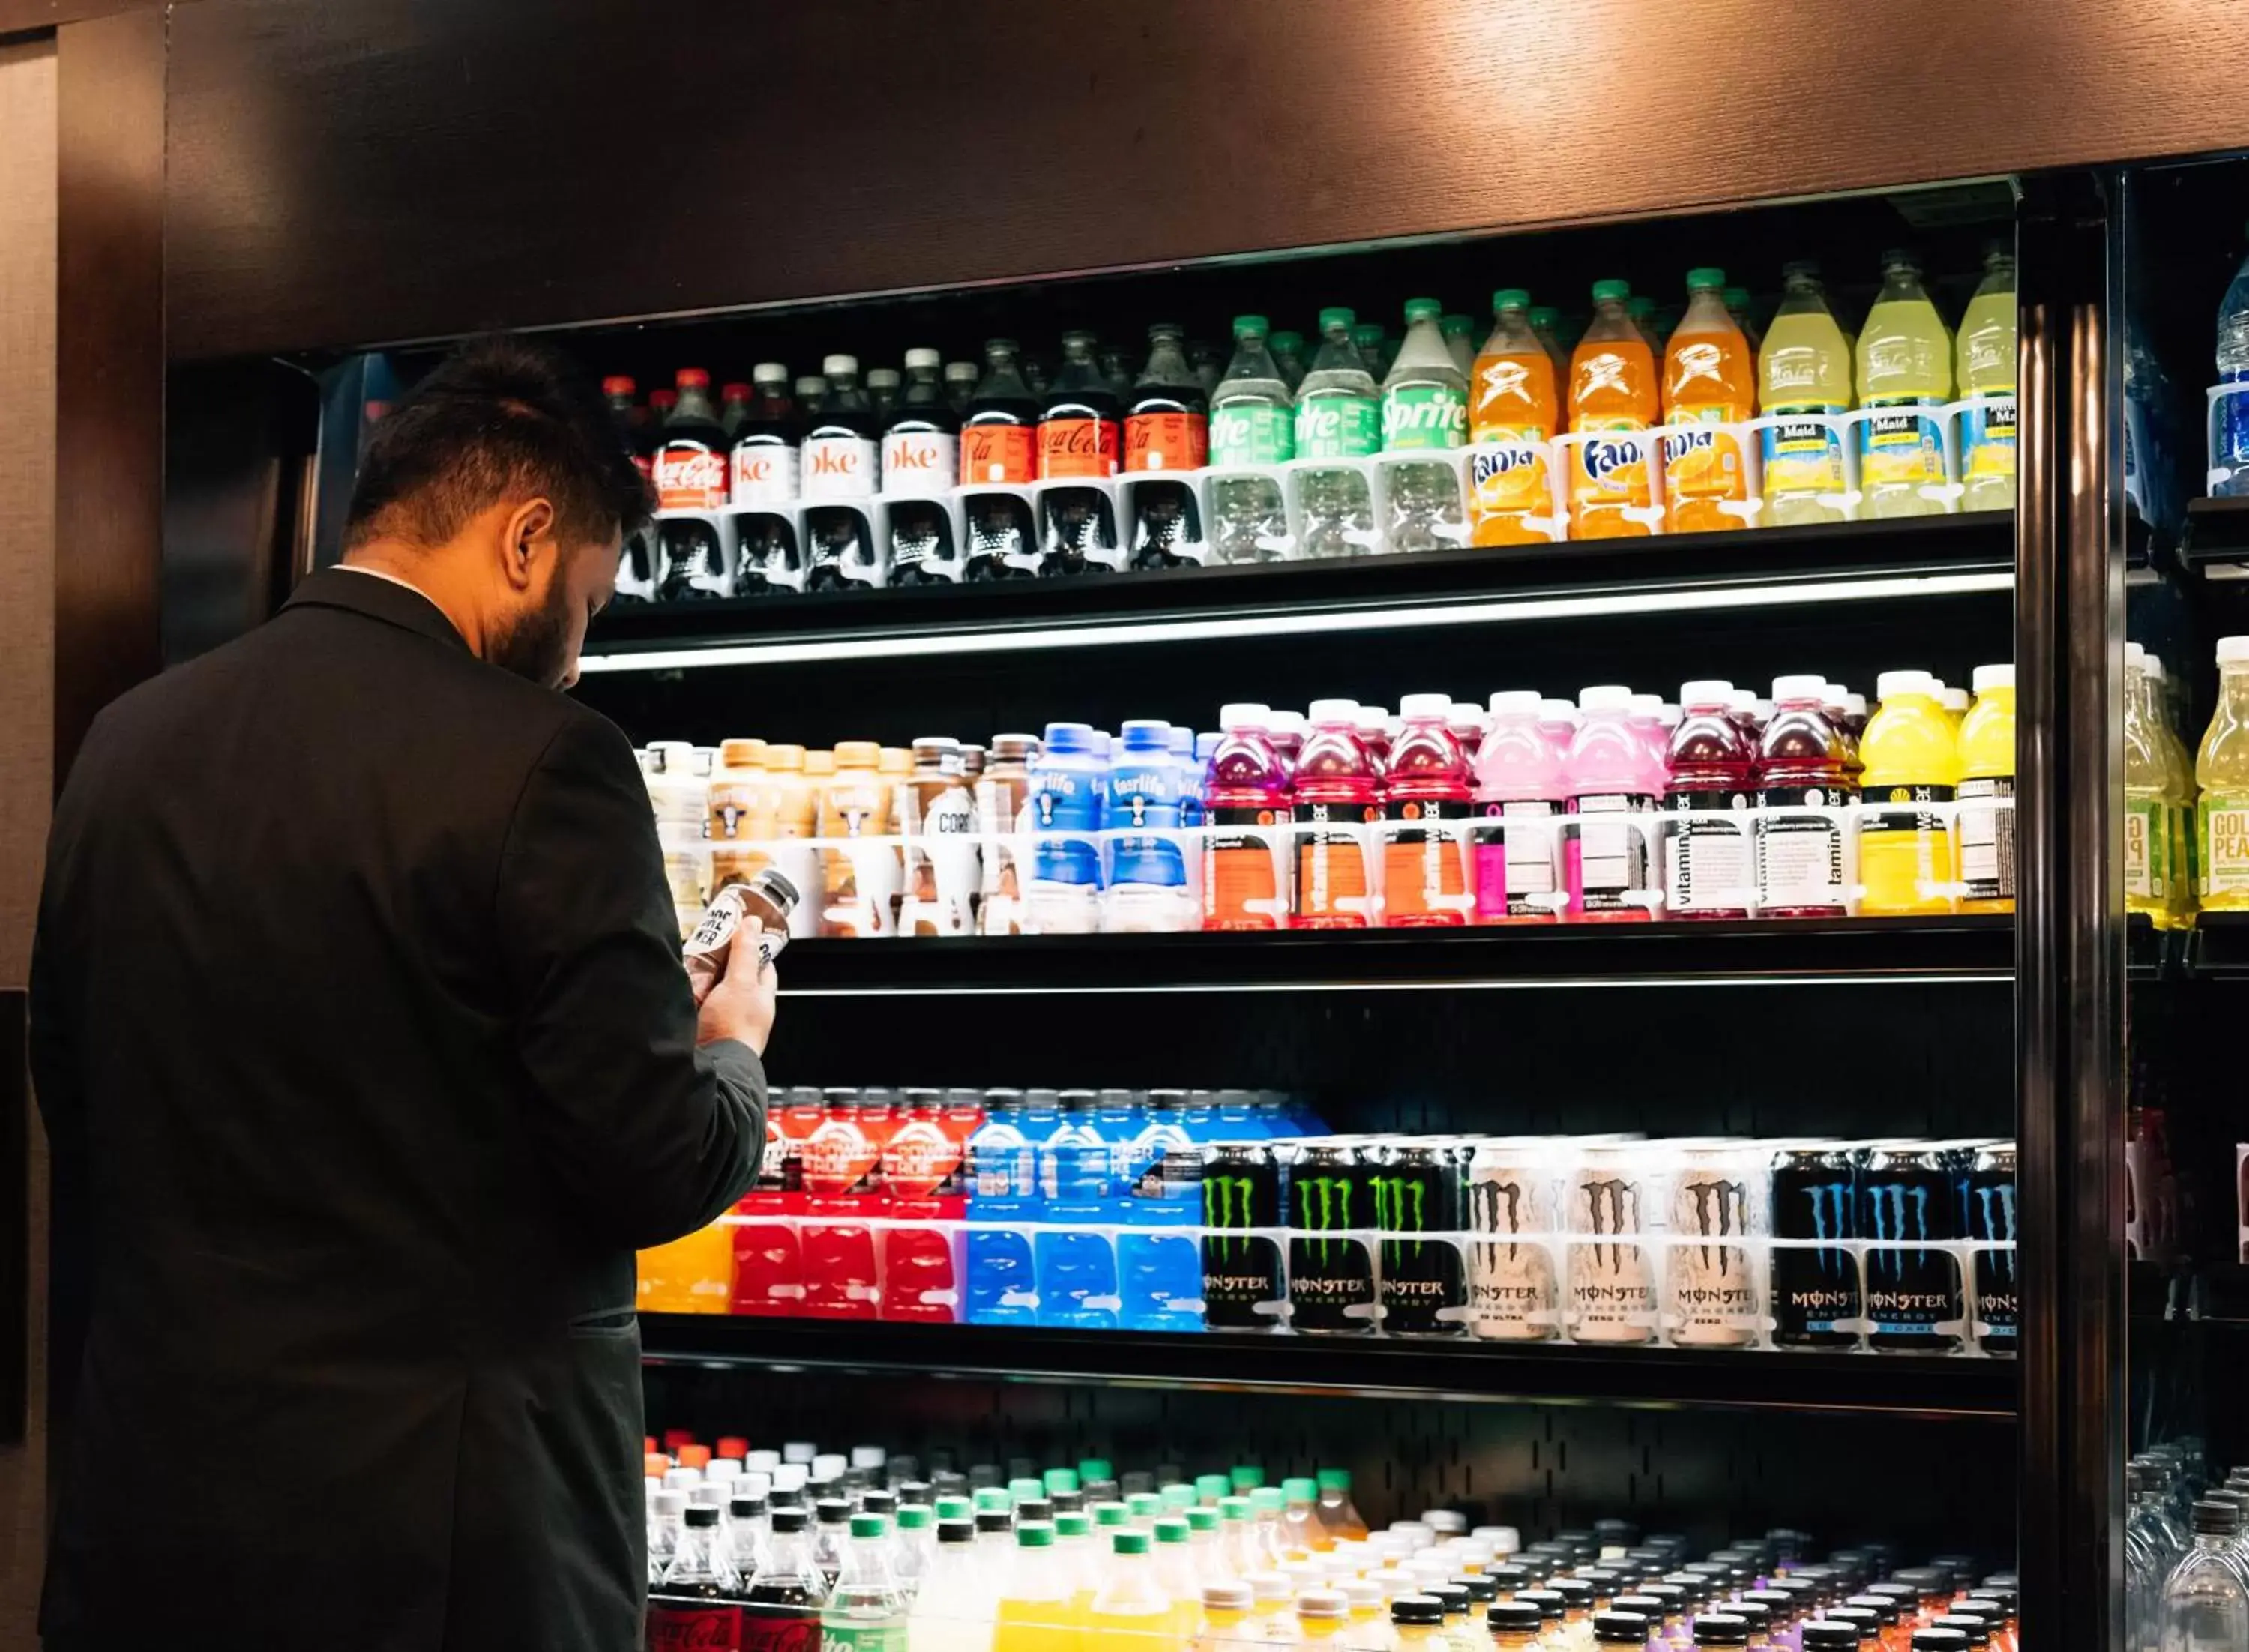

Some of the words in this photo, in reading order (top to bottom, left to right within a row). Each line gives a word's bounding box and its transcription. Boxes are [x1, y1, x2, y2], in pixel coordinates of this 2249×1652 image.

[1382, 393, 1466, 438] Sprite
[1876, 417, 1908, 432] Maid
[1783, 423, 1816, 438] Maid
[1584, 438, 1643, 478] Fan
